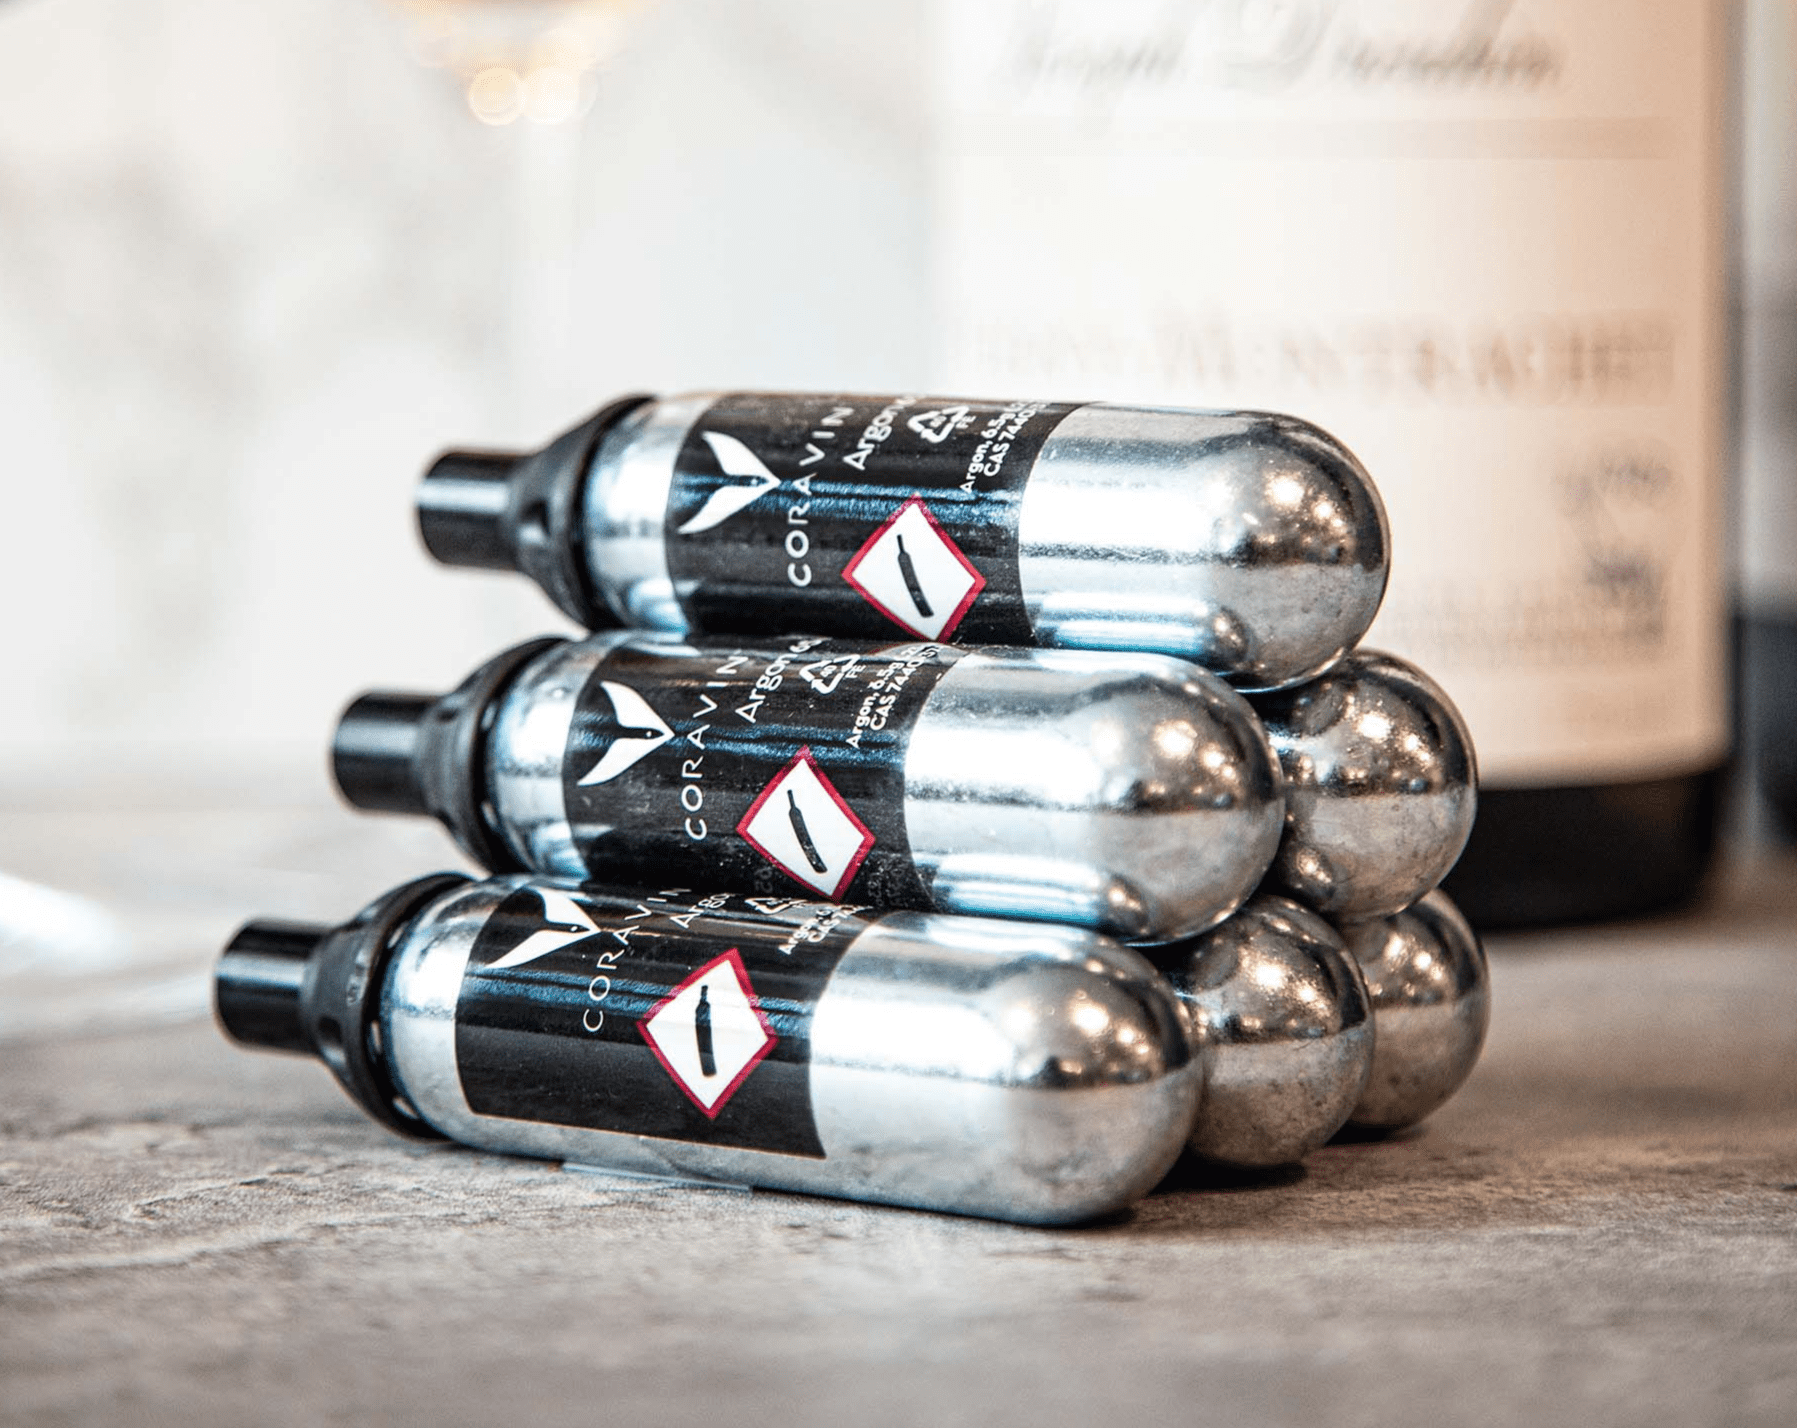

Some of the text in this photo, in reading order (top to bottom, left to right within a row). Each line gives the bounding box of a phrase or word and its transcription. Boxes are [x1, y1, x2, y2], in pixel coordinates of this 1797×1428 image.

[983, 443, 1010, 477] CAS
[785, 406, 854, 588] CORAVIN
[735, 653, 798, 723] Argon
[870, 694, 896, 731] CAS
[682, 655, 748, 840] CORAVIN
